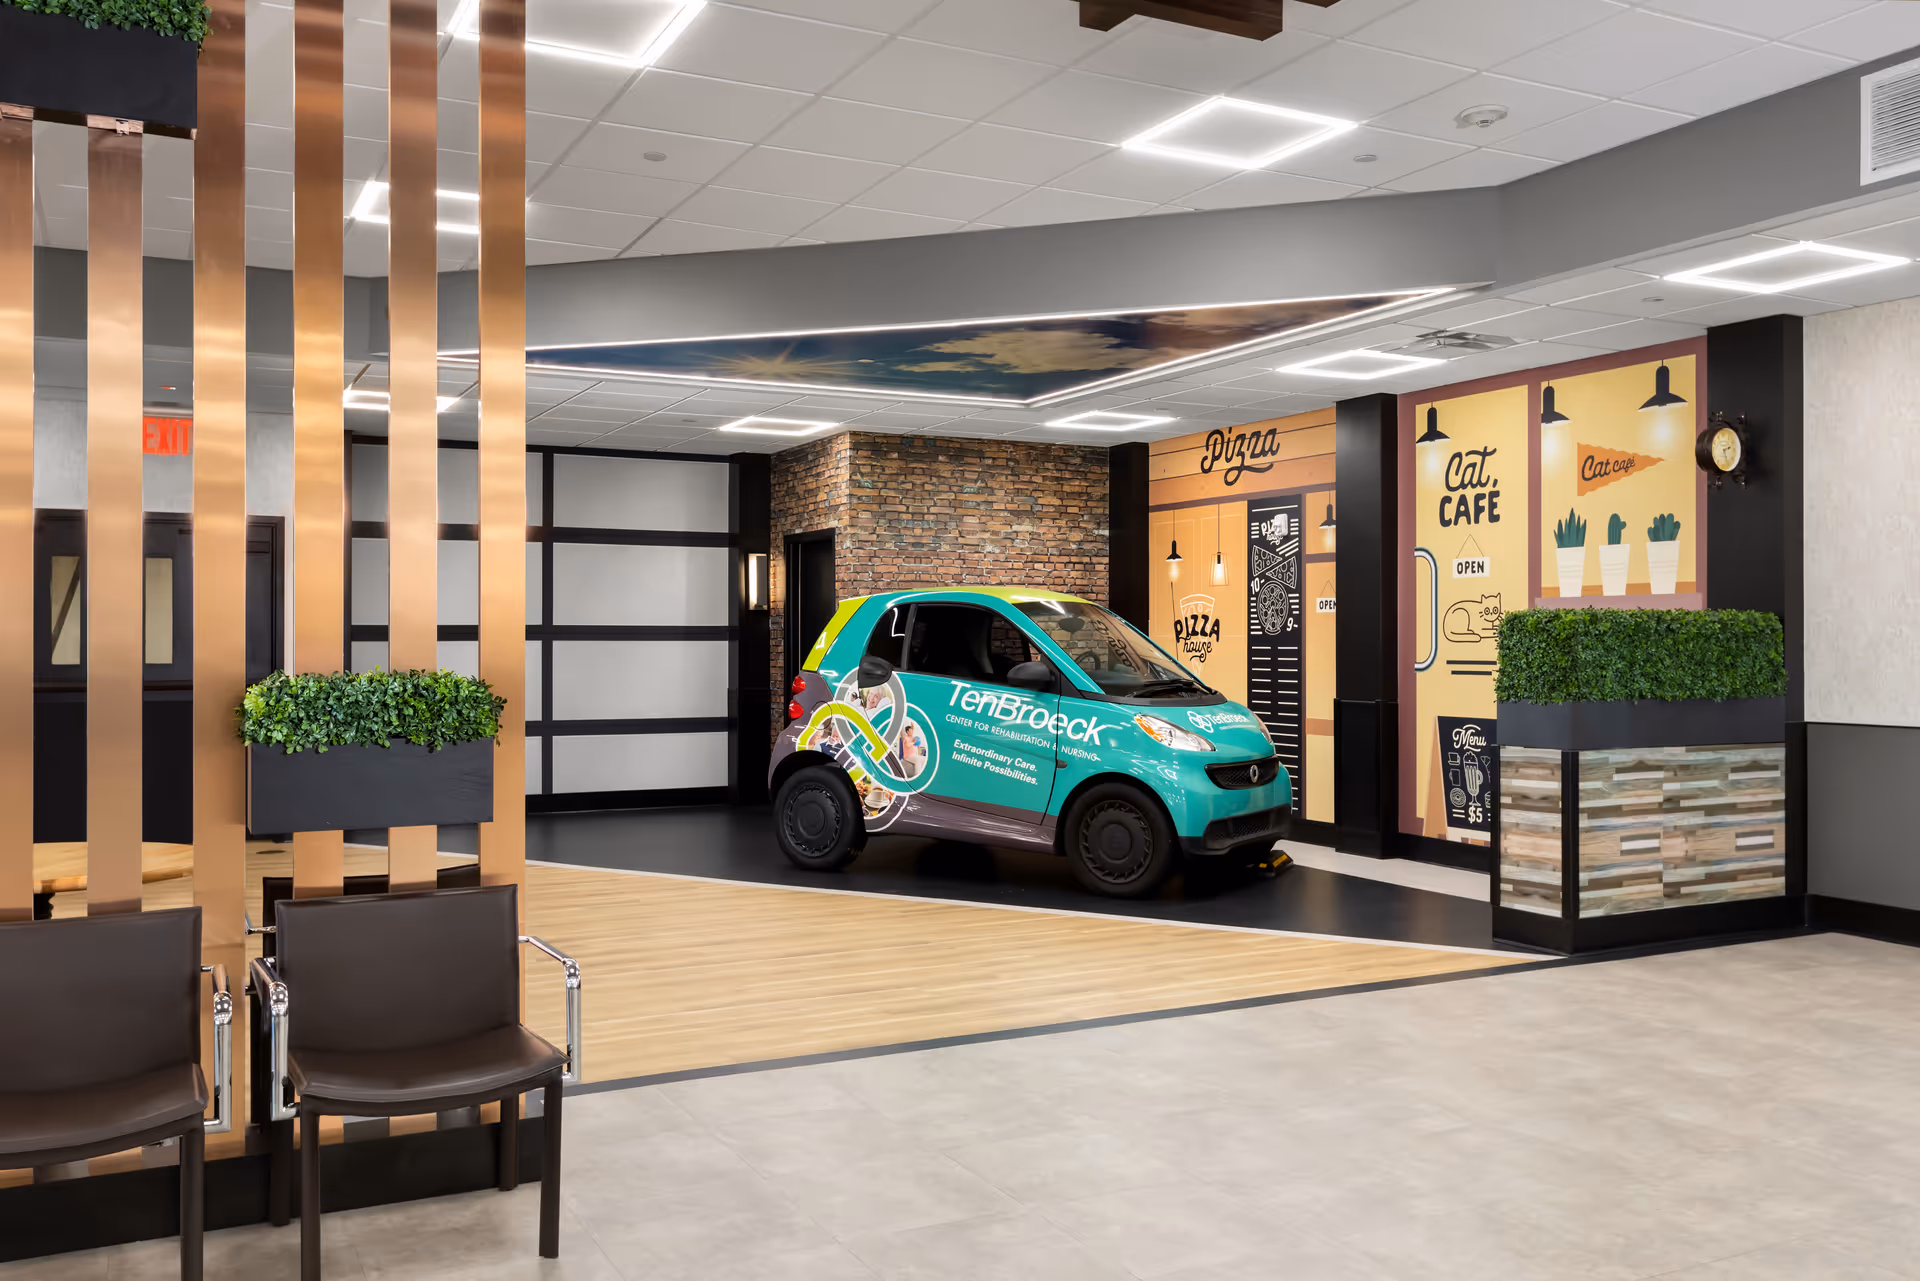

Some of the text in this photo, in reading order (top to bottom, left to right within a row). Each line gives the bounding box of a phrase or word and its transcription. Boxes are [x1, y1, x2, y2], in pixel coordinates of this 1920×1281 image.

[143, 417, 192, 456] EXIT
[1201, 426, 1280, 486] Pizza
[1581, 455, 1636, 481] Cat café
[1456, 560, 1485, 575] OPEN
[1174, 614, 1220, 643] PIZZA
[1183, 633, 1213, 663] house
[949, 680, 1108, 746] TenBroeck
[945, 714, 973, 728] CENTER
[975, 721, 990, 732] FOR
[991, 726, 1050, 749] REHABILITATION
[1061, 745, 1098, 762] NURSING
[1452, 727, 1487, 752] Menu
[952, 751, 1038, 786] Infinite Possibilities.
[954, 739, 1037, 772] Extraordinary Care.
[1468, 806, 1483, 824] $5
